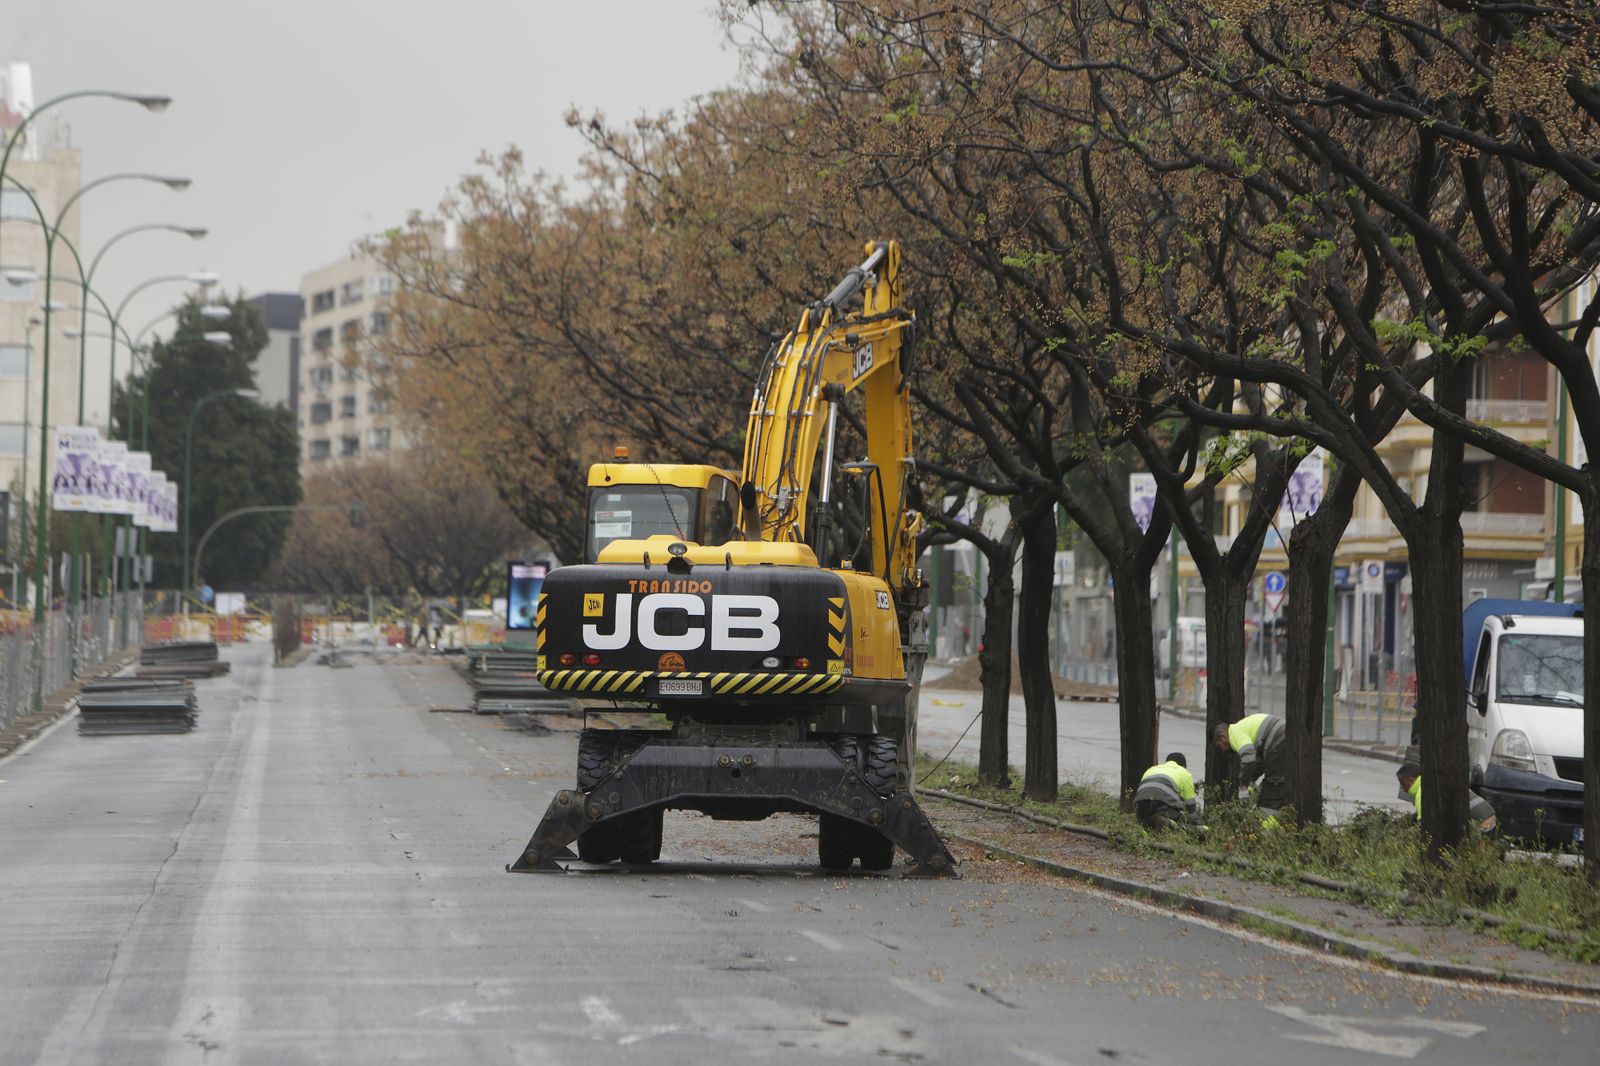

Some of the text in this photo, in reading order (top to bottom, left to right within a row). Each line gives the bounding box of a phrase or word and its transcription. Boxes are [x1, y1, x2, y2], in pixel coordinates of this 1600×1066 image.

[853, 342, 873, 379] JCB
[628, 580, 713, 594] TRANSIDO
[876, 591, 890, 609] JCB
[582, 593, 781, 652] JCB
